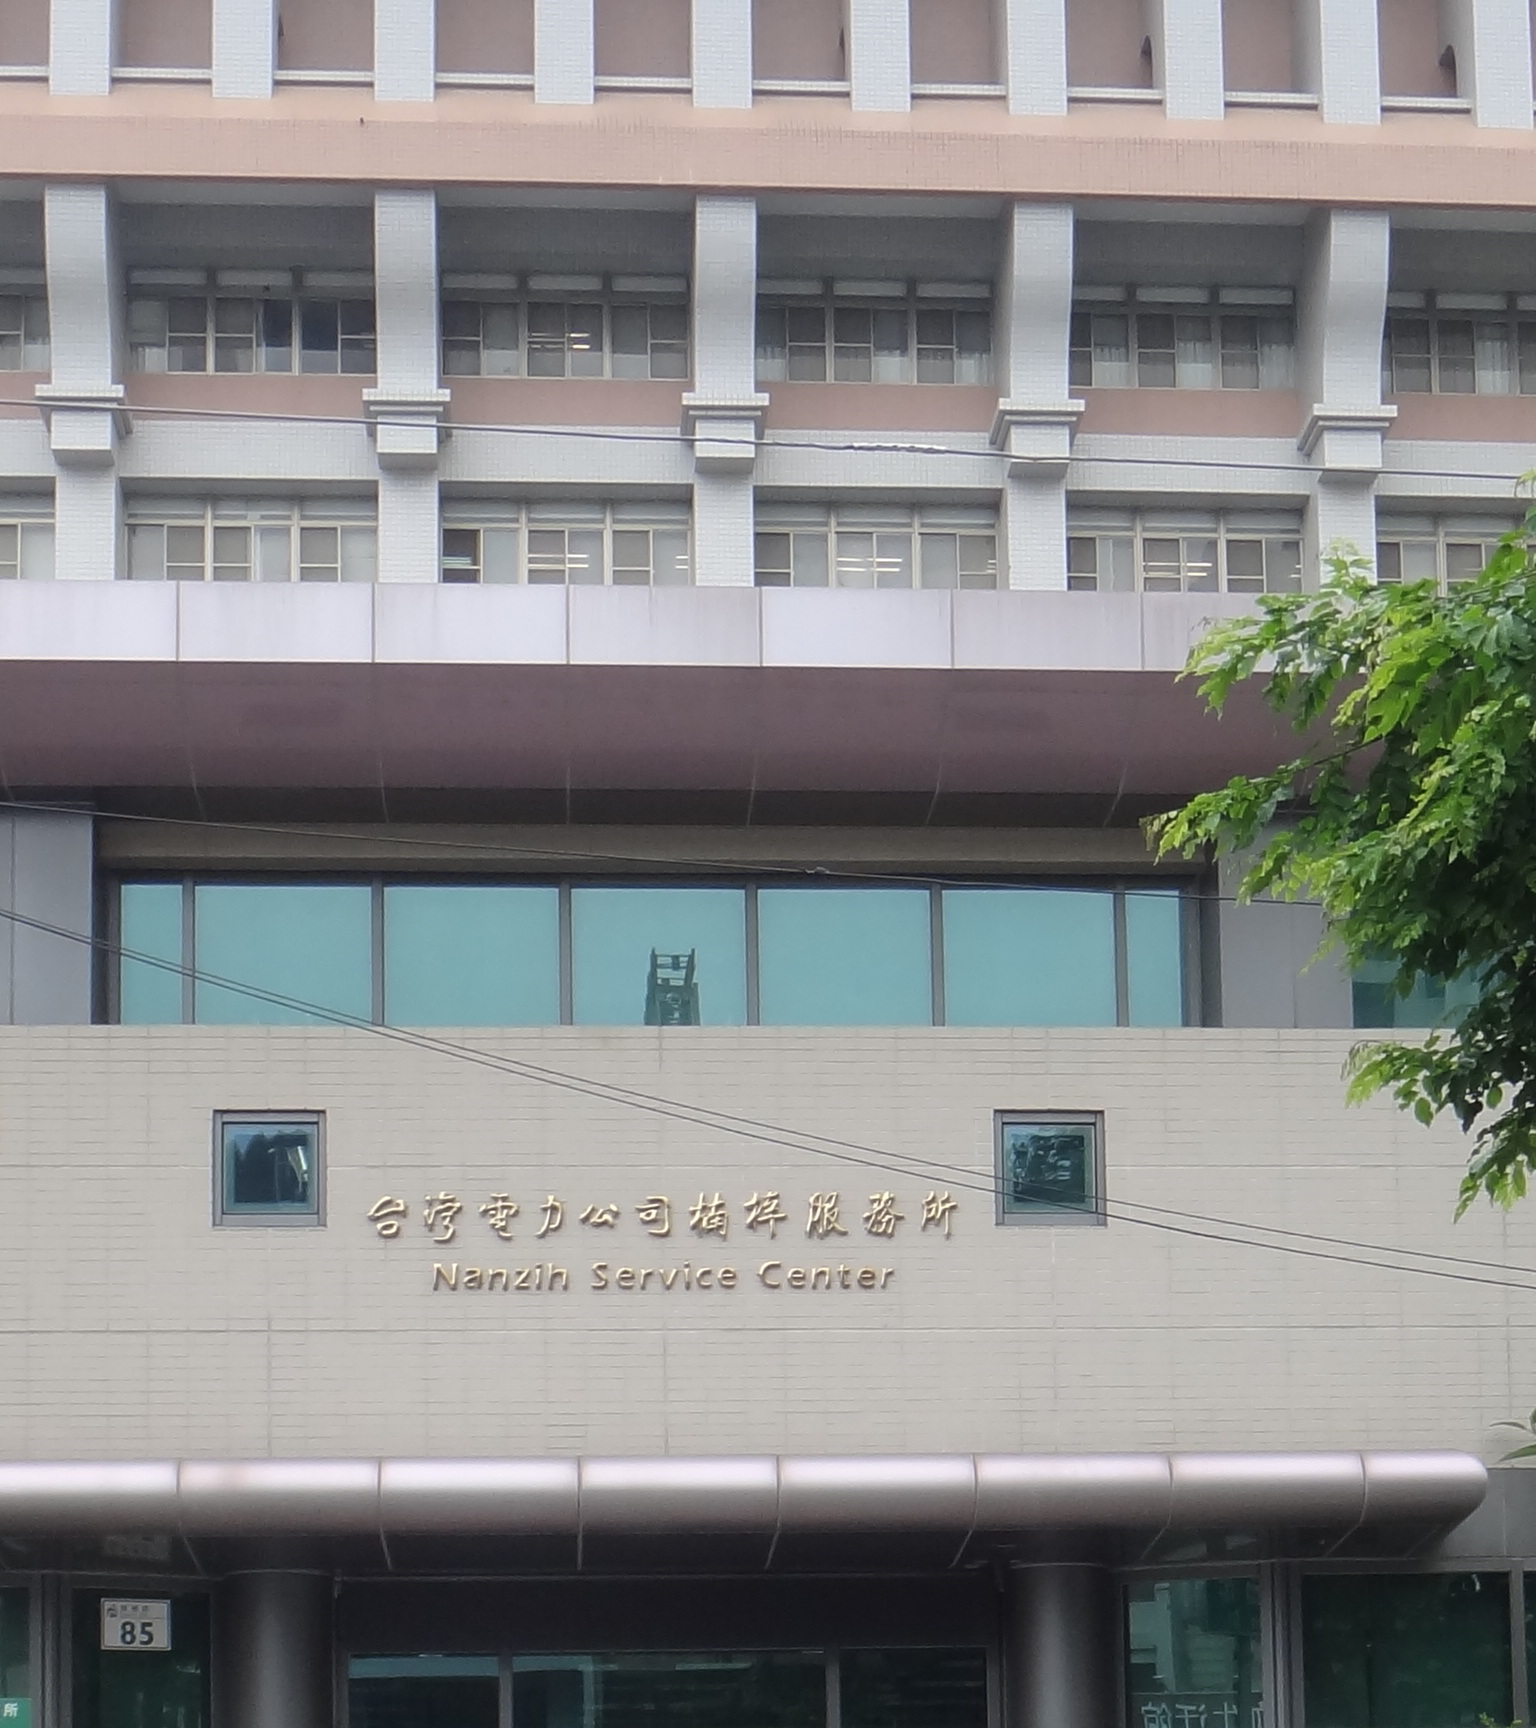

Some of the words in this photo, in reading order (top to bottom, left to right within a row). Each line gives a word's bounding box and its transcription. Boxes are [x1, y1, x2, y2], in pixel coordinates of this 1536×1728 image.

[432, 1262, 569, 1291] Nanzih
[590, 1262, 737, 1291] Service
[758, 1260, 895, 1290] Center
[120, 1621, 154, 1646] 85
